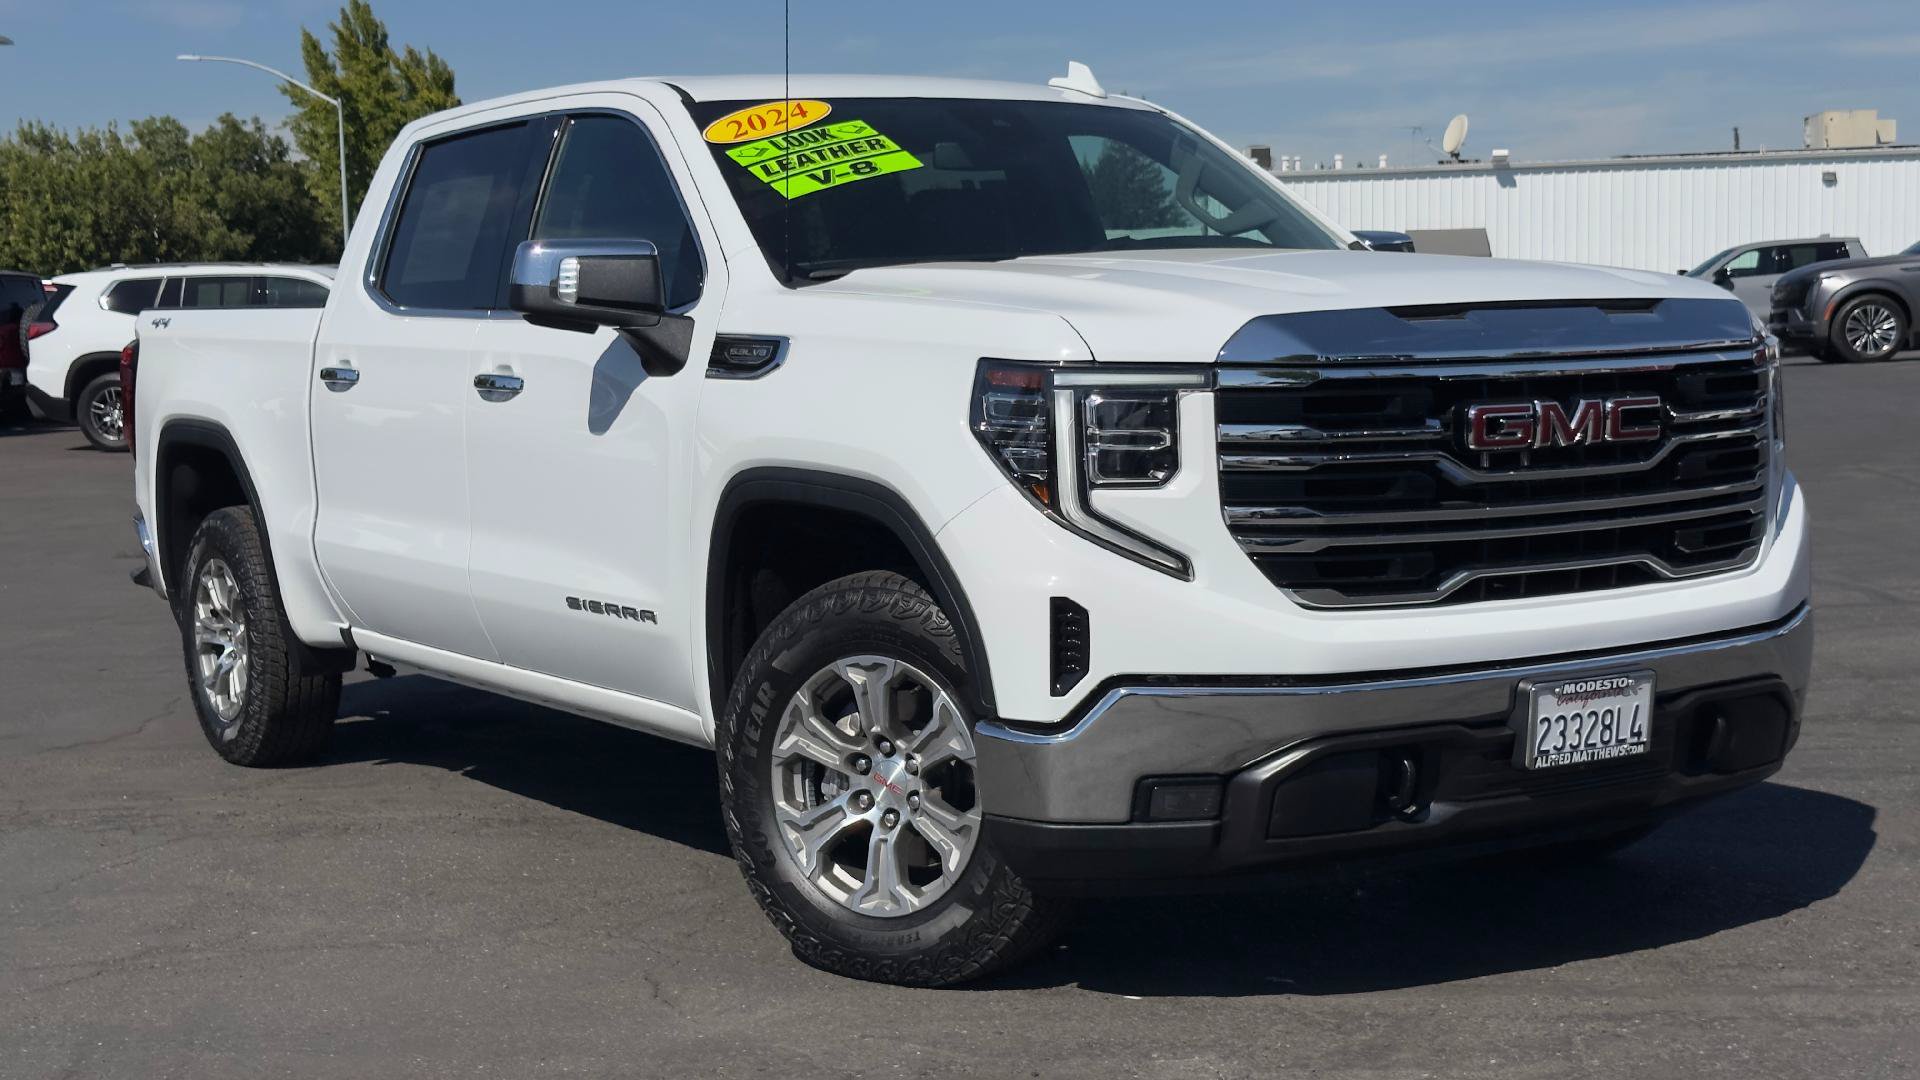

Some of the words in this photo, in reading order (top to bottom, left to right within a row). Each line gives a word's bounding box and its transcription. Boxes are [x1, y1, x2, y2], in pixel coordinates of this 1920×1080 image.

[726, 102, 809, 140] 2024
[767, 127, 837, 151] LOOK
[759, 138, 888, 178] LEATHER
[806, 160, 882, 186] V-8
[1468, 396, 1661, 450] GMC
[565, 596, 658, 625] SIERRA
[1562, 677, 1628, 695] MODESTO
[1536, 703, 1643, 755] 23328L4
[873, 772, 905, 797] GMC
